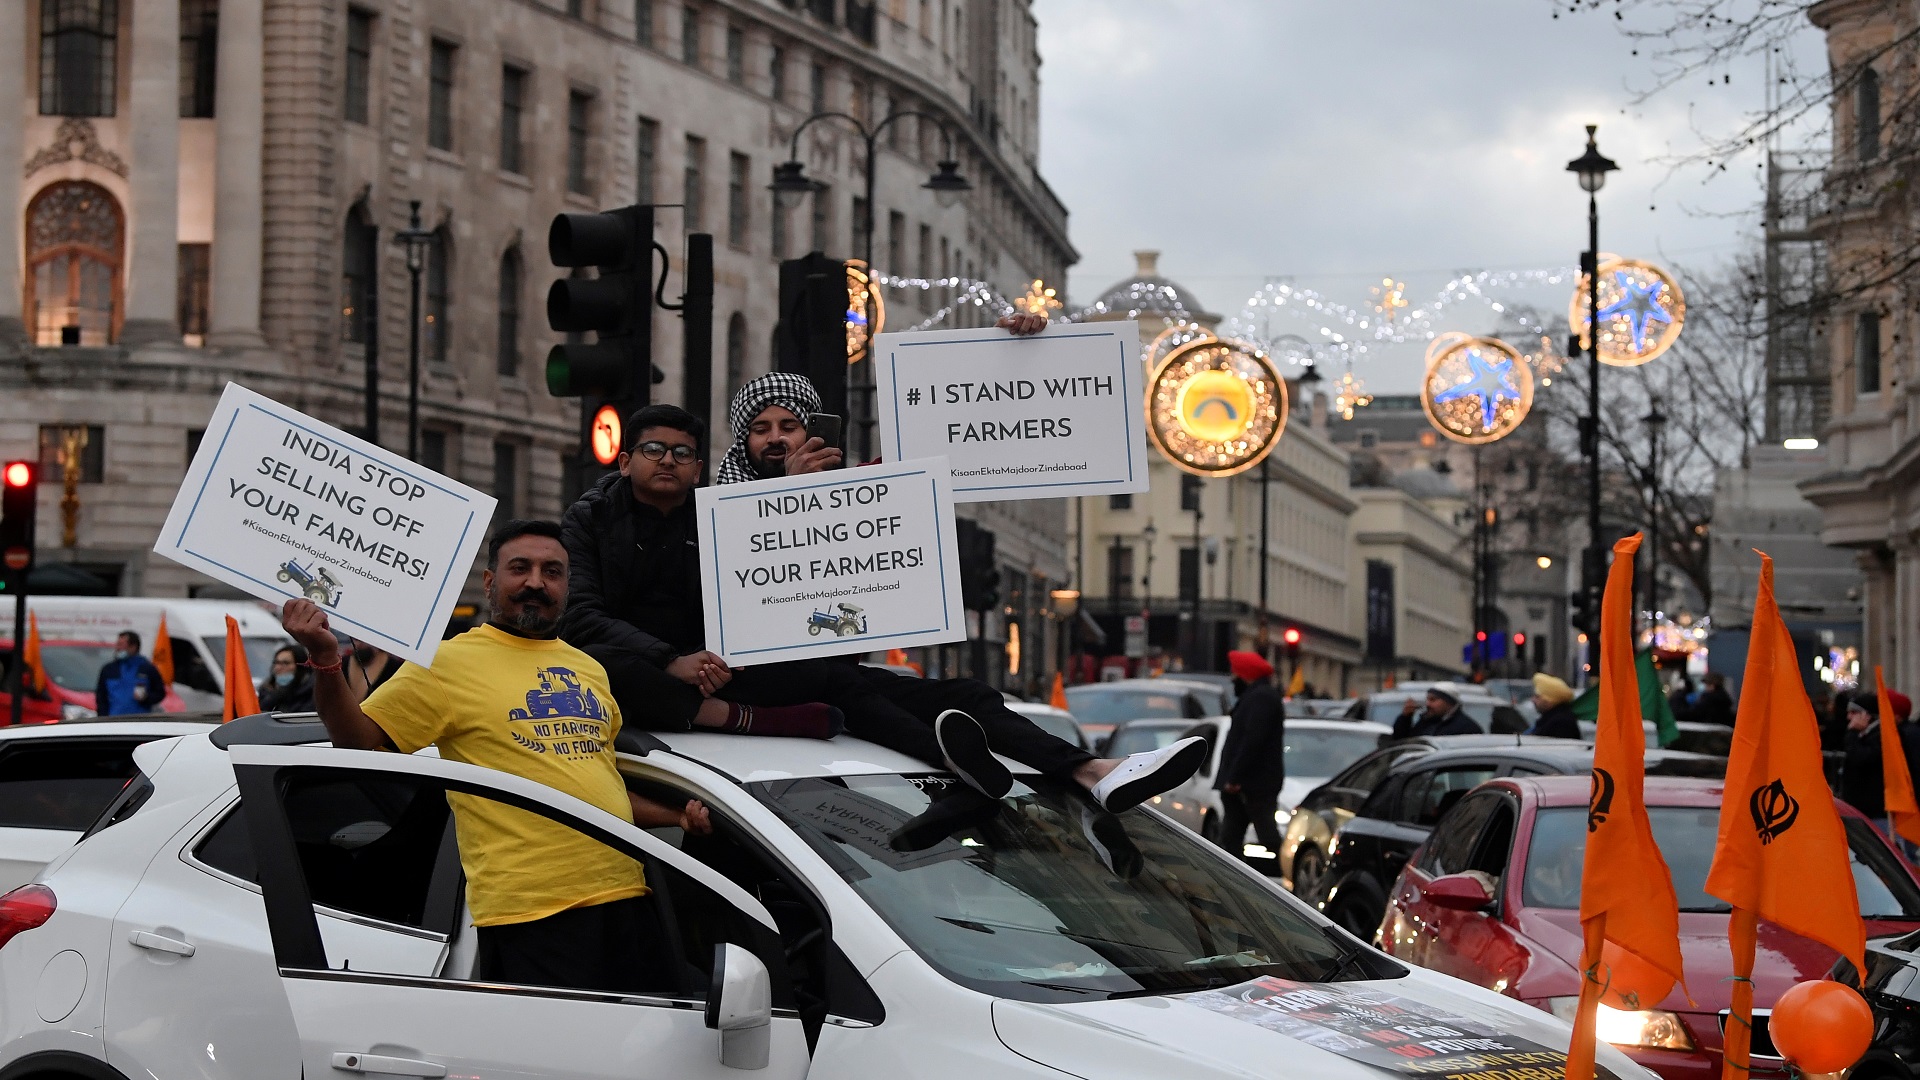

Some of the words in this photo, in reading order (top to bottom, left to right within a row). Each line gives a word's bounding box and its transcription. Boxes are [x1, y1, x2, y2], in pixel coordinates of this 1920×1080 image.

[906, 387, 921, 406] #
[930, 384, 936, 405] I
[945, 380, 1036, 404] STAND
[1042, 375, 1113, 399] WITH
[947, 417, 1072, 444] FARMERS
[282, 428, 351, 475] INDIA
[358, 463, 426, 502] STOP
[256, 456, 367, 516] SELLING
[372, 506, 425, 538] OFF
[757, 492, 823, 518] INDIA
[829, 483, 889, 509] STOP
[229, 477, 300, 526] YOUR
[305, 513, 430, 581] FARMERS!
[750, 522, 849, 553] SELLING
[855, 515, 902, 539] OFF
[242, 518, 393, 588] #KisaanEktaMajdoorZindabaad
[734, 563, 803, 589] YOUR
[809, 546, 924, 580] FARMERS!
[761, 580, 900, 606] #KisaanEktaMajdoorZindabaad
[534, 724, 550, 737] NO
[554, 721, 600, 738] FARMERS
[552, 742, 571, 755] NO
[572, 739, 601, 754] FOOD
[1361, 1029, 1410, 1044] NO
[1387, 1043, 1436, 1060] NO
[1418, 1037, 1516, 1055] FUTURE
[1395, 1052, 1513, 1074] KISSAN
[1500, 1051, 1568, 1065] EKTA
[1446, 1065, 1567, 1080] ZINDABAA
